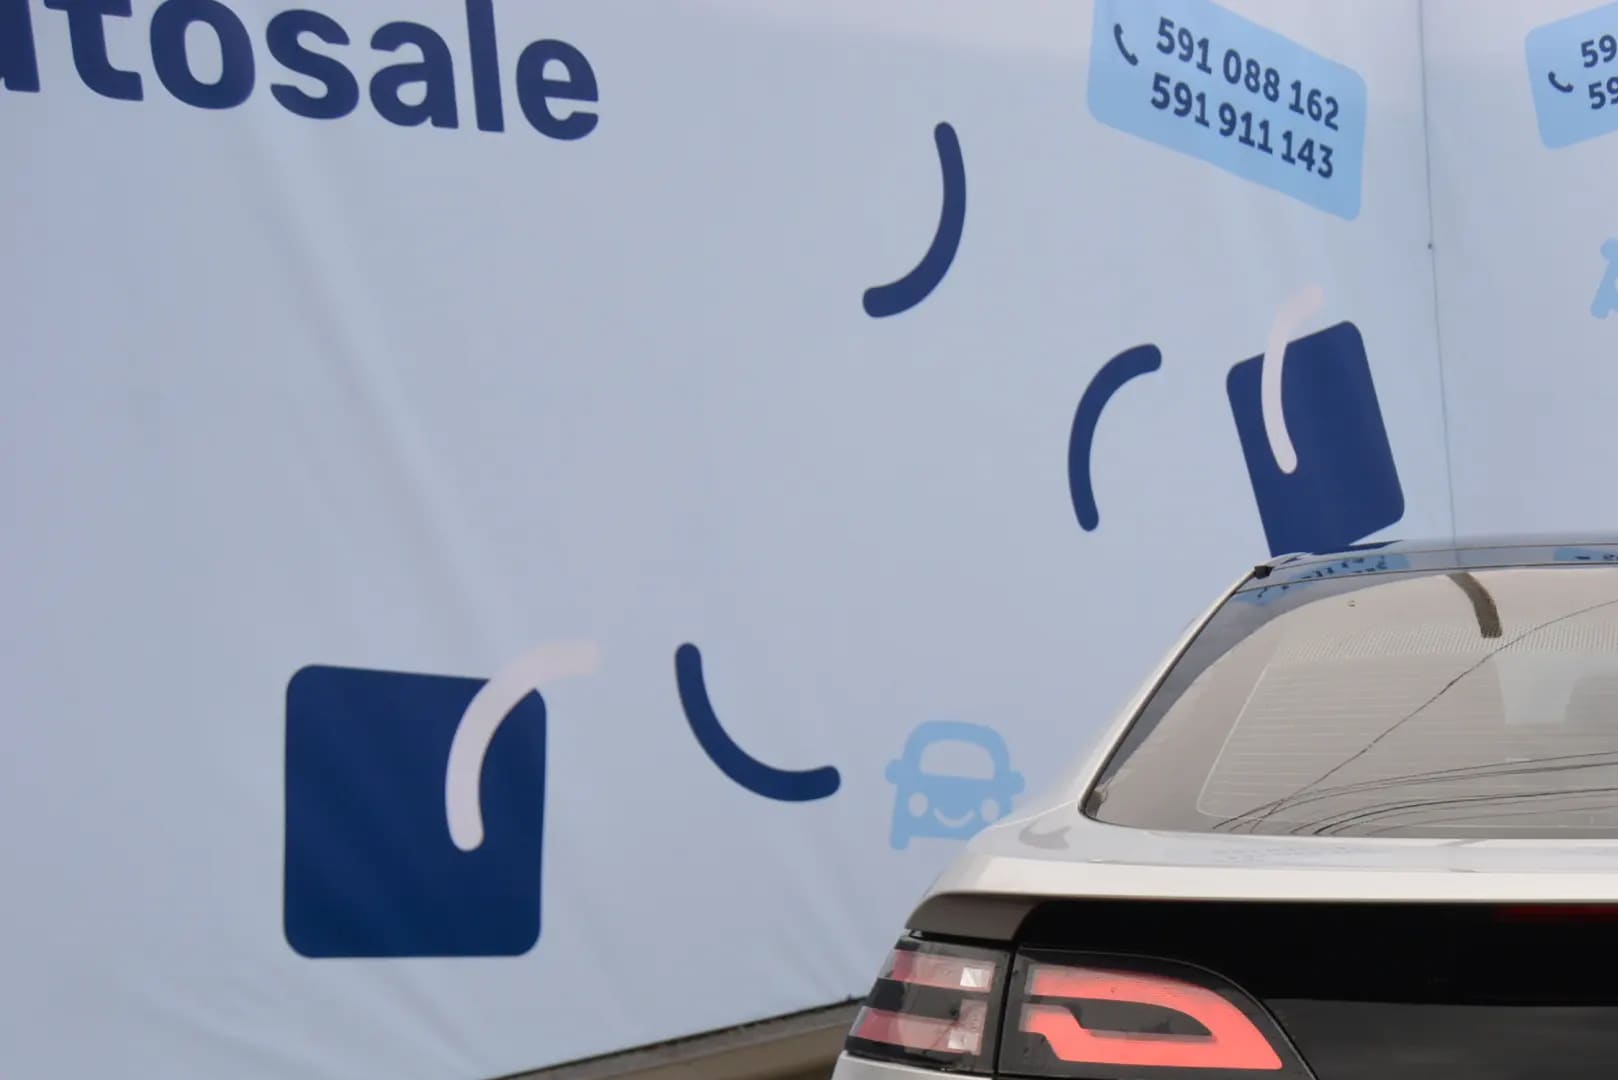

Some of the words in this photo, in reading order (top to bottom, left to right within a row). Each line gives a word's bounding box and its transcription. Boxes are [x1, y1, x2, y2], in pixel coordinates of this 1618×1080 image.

[1151, 72, 1210, 128] 591
[1218, 102, 1273, 155] 911
[1281, 130, 1334, 179] 143
[1156, 16, 1212, 75] 591
[1223, 48, 1280, 103] 088
[1288, 79, 1339, 132] 162
